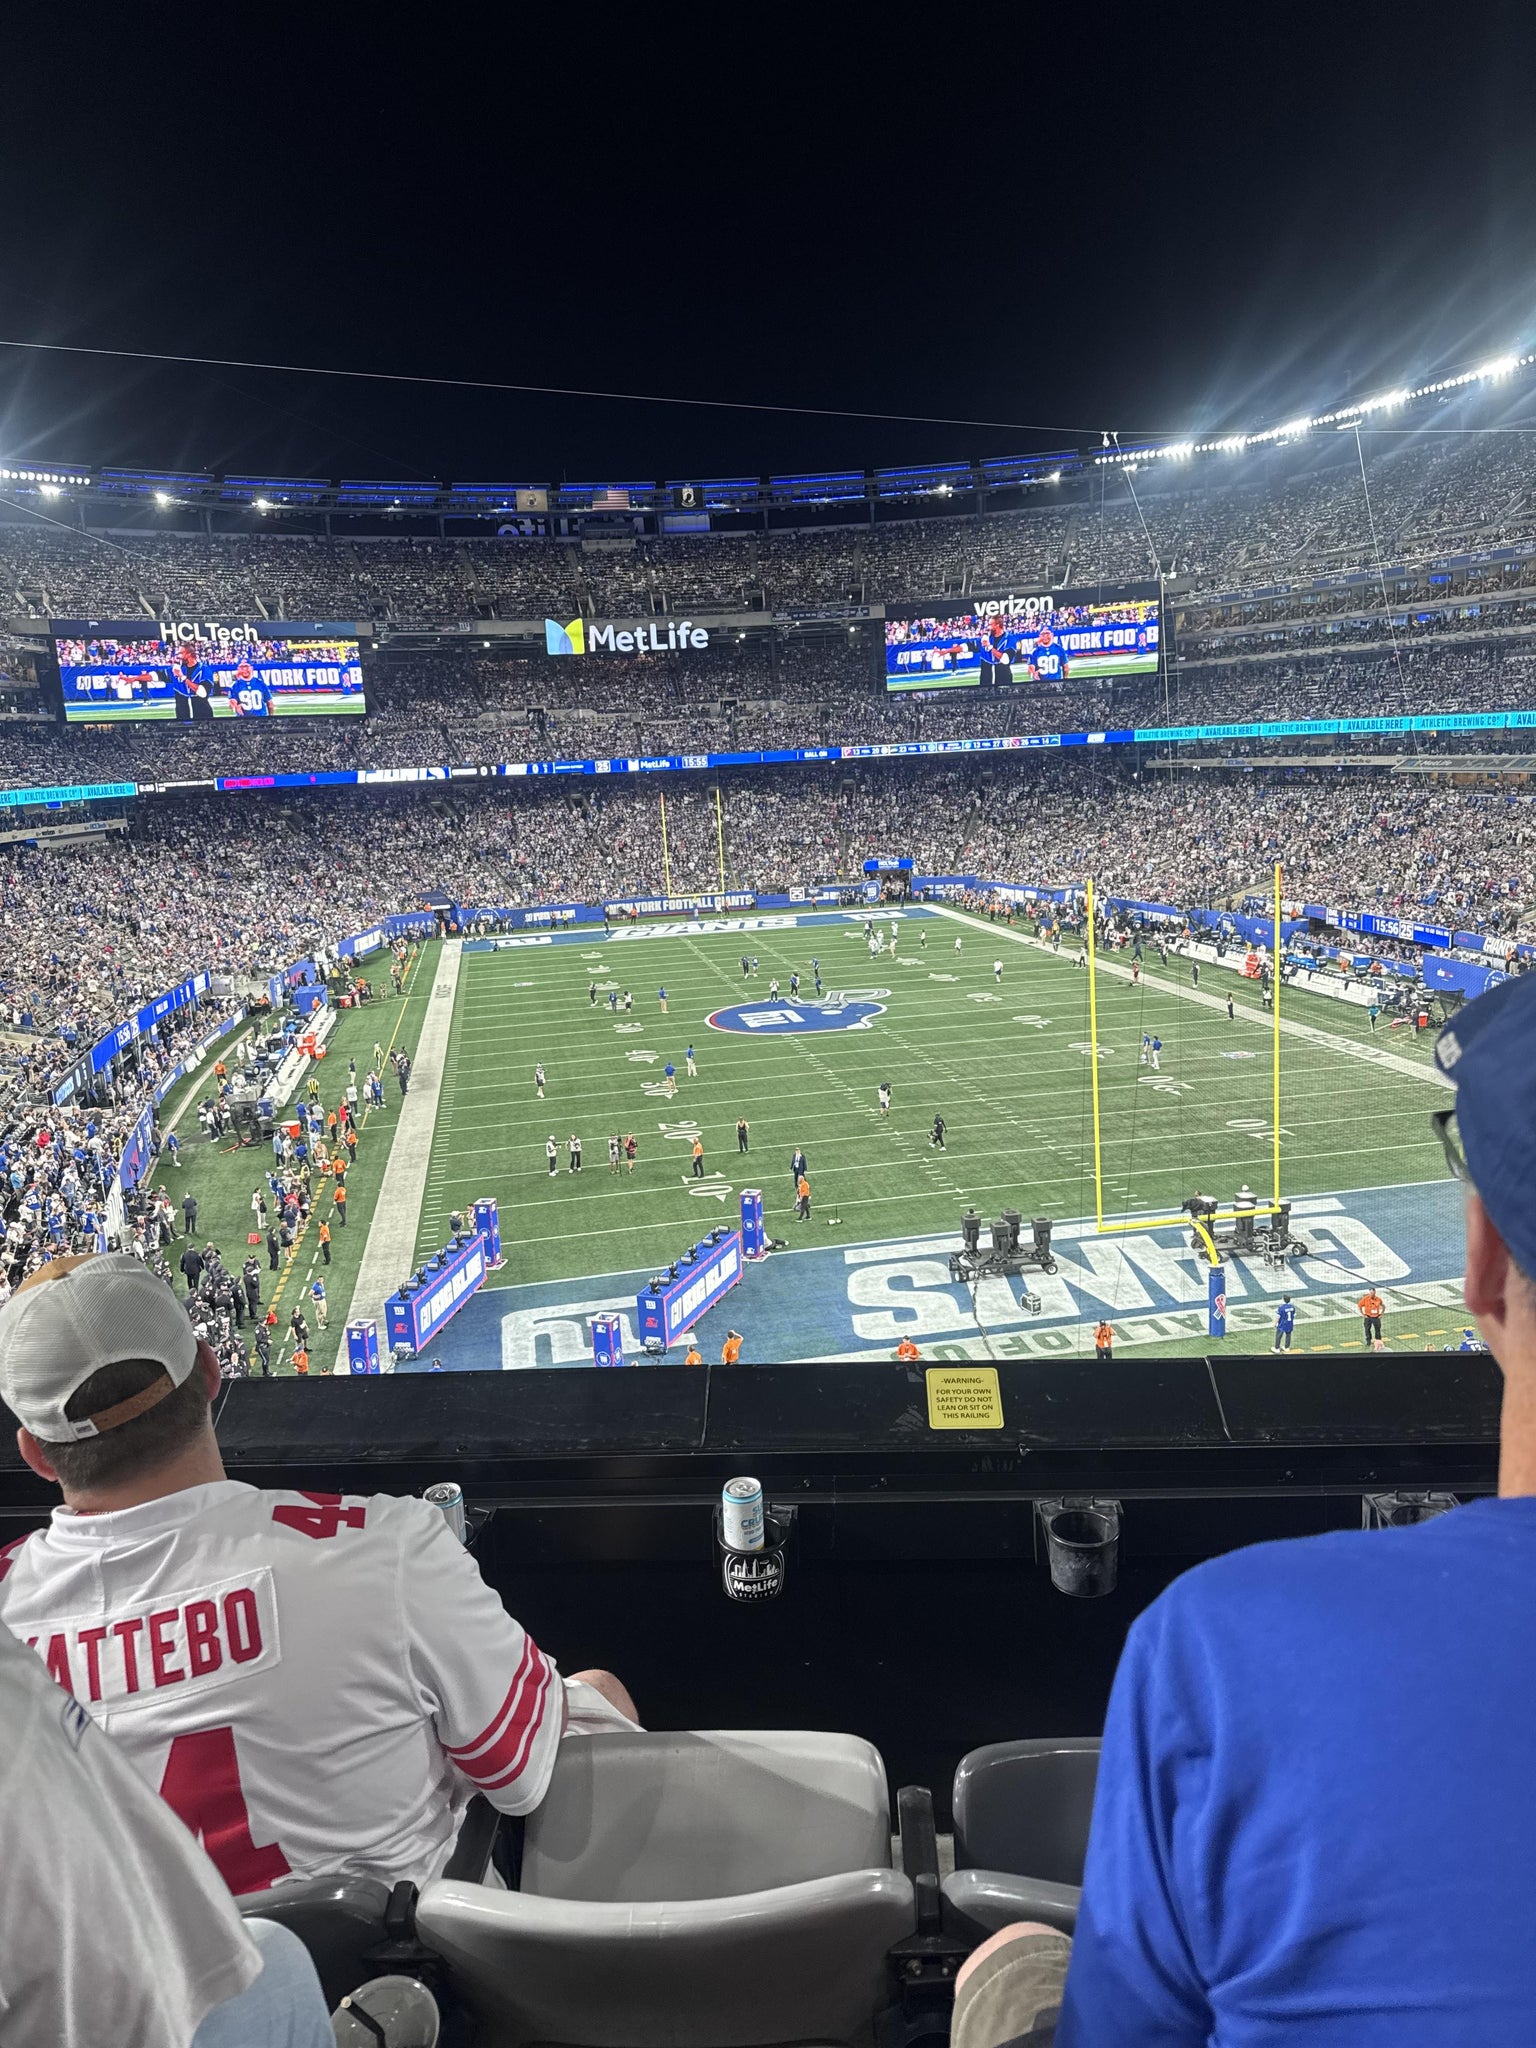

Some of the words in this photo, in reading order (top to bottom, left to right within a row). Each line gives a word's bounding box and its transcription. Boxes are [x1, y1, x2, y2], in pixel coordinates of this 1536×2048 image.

[973, 594, 1053, 617] verizon
[159, 622, 258, 641] HCLTech
[589, 621, 709, 652] MetLife
[1060, 631, 1102, 651] YORK
[1038, 655, 1059, 675] 90
[261, 669, 306, 687] YORK
[238, 689, 262, 710] 90
[1205, 727, 1237, 736] AVAILABLE
[1238, 726, 1253, 735] HERE
[1268, 723, 1294, 733] ATHLETIC
[1295, 723, 1322, 732] BREWING
[1347, 719, 1384, 730] AVAILABLE
[1385, 719, 1403, 729] HERE
[1421, 717, 1451, 728] ATHLETIC
[1453, 716, 1485, 727] BREWING
[1137, 730, 1159, 740] ATHLETIC
[1160, 729, 1183, 739] BREWING
[598, 763, 609, 771] 25
[641, 758, 670, 768] MetLife
[683, 757, 708, 767] 15:55
[24, 790, 45, 800] ATHLETIC
[46, 789, 68, 799] BREWING
[87, 785, 113, 797] AVAILABLE
[114, 784, 126, 795] HERE
[635, 900, 662, 912] YORK
[714, 893, 752, 907] GIANTS
[607, 917, 797, 940] GIANTS
[1375, 918, 1399, 935] 15:56
[1400, 924, 1412, 937] 25
[420, 1302, 432, 1335] GO
[431, 1280, 454, 1324] BIG
[452, 1250, 484, 1304] BLUE
[670, 1296, 683, 1330] GO
[682, 1277, 706, 1319] BIG
[704, 1247, 738, 1298] BLUE
[1000, 1331, 1073, 1356] OF
[733, 1578, 778, 1594] MetLife
